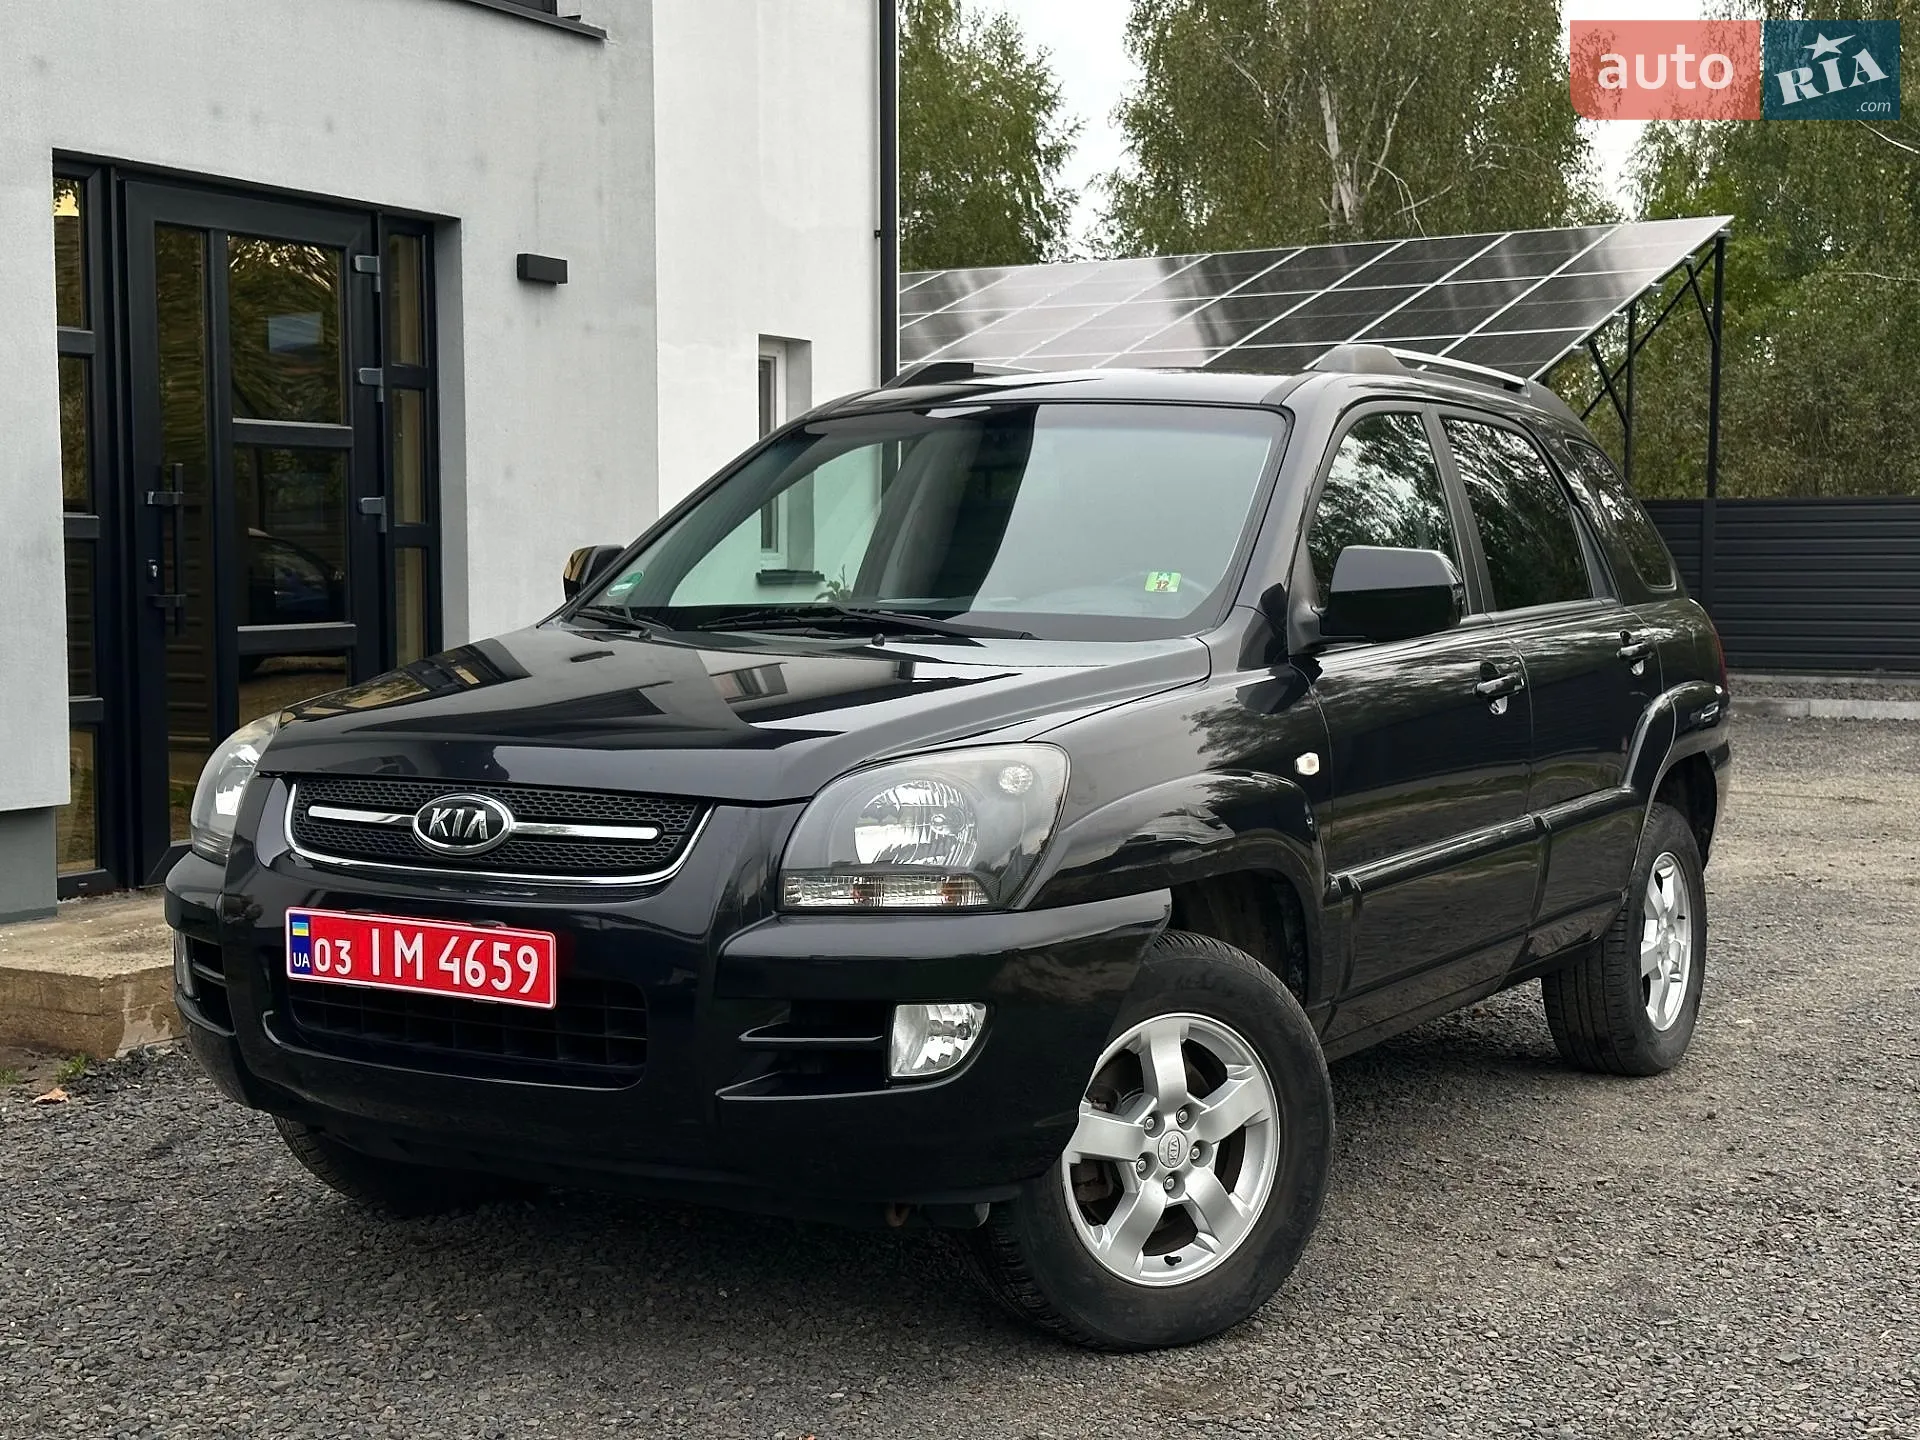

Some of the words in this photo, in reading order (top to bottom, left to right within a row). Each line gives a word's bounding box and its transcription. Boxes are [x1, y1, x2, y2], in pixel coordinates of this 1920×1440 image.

[428, 807, 488, 839] KIA
[293, 952, 310, 968] UA
[314, 937, 352, 975] 03
[371, 928, 424, 981] IM
[438, 935, 539, 994] 4659
